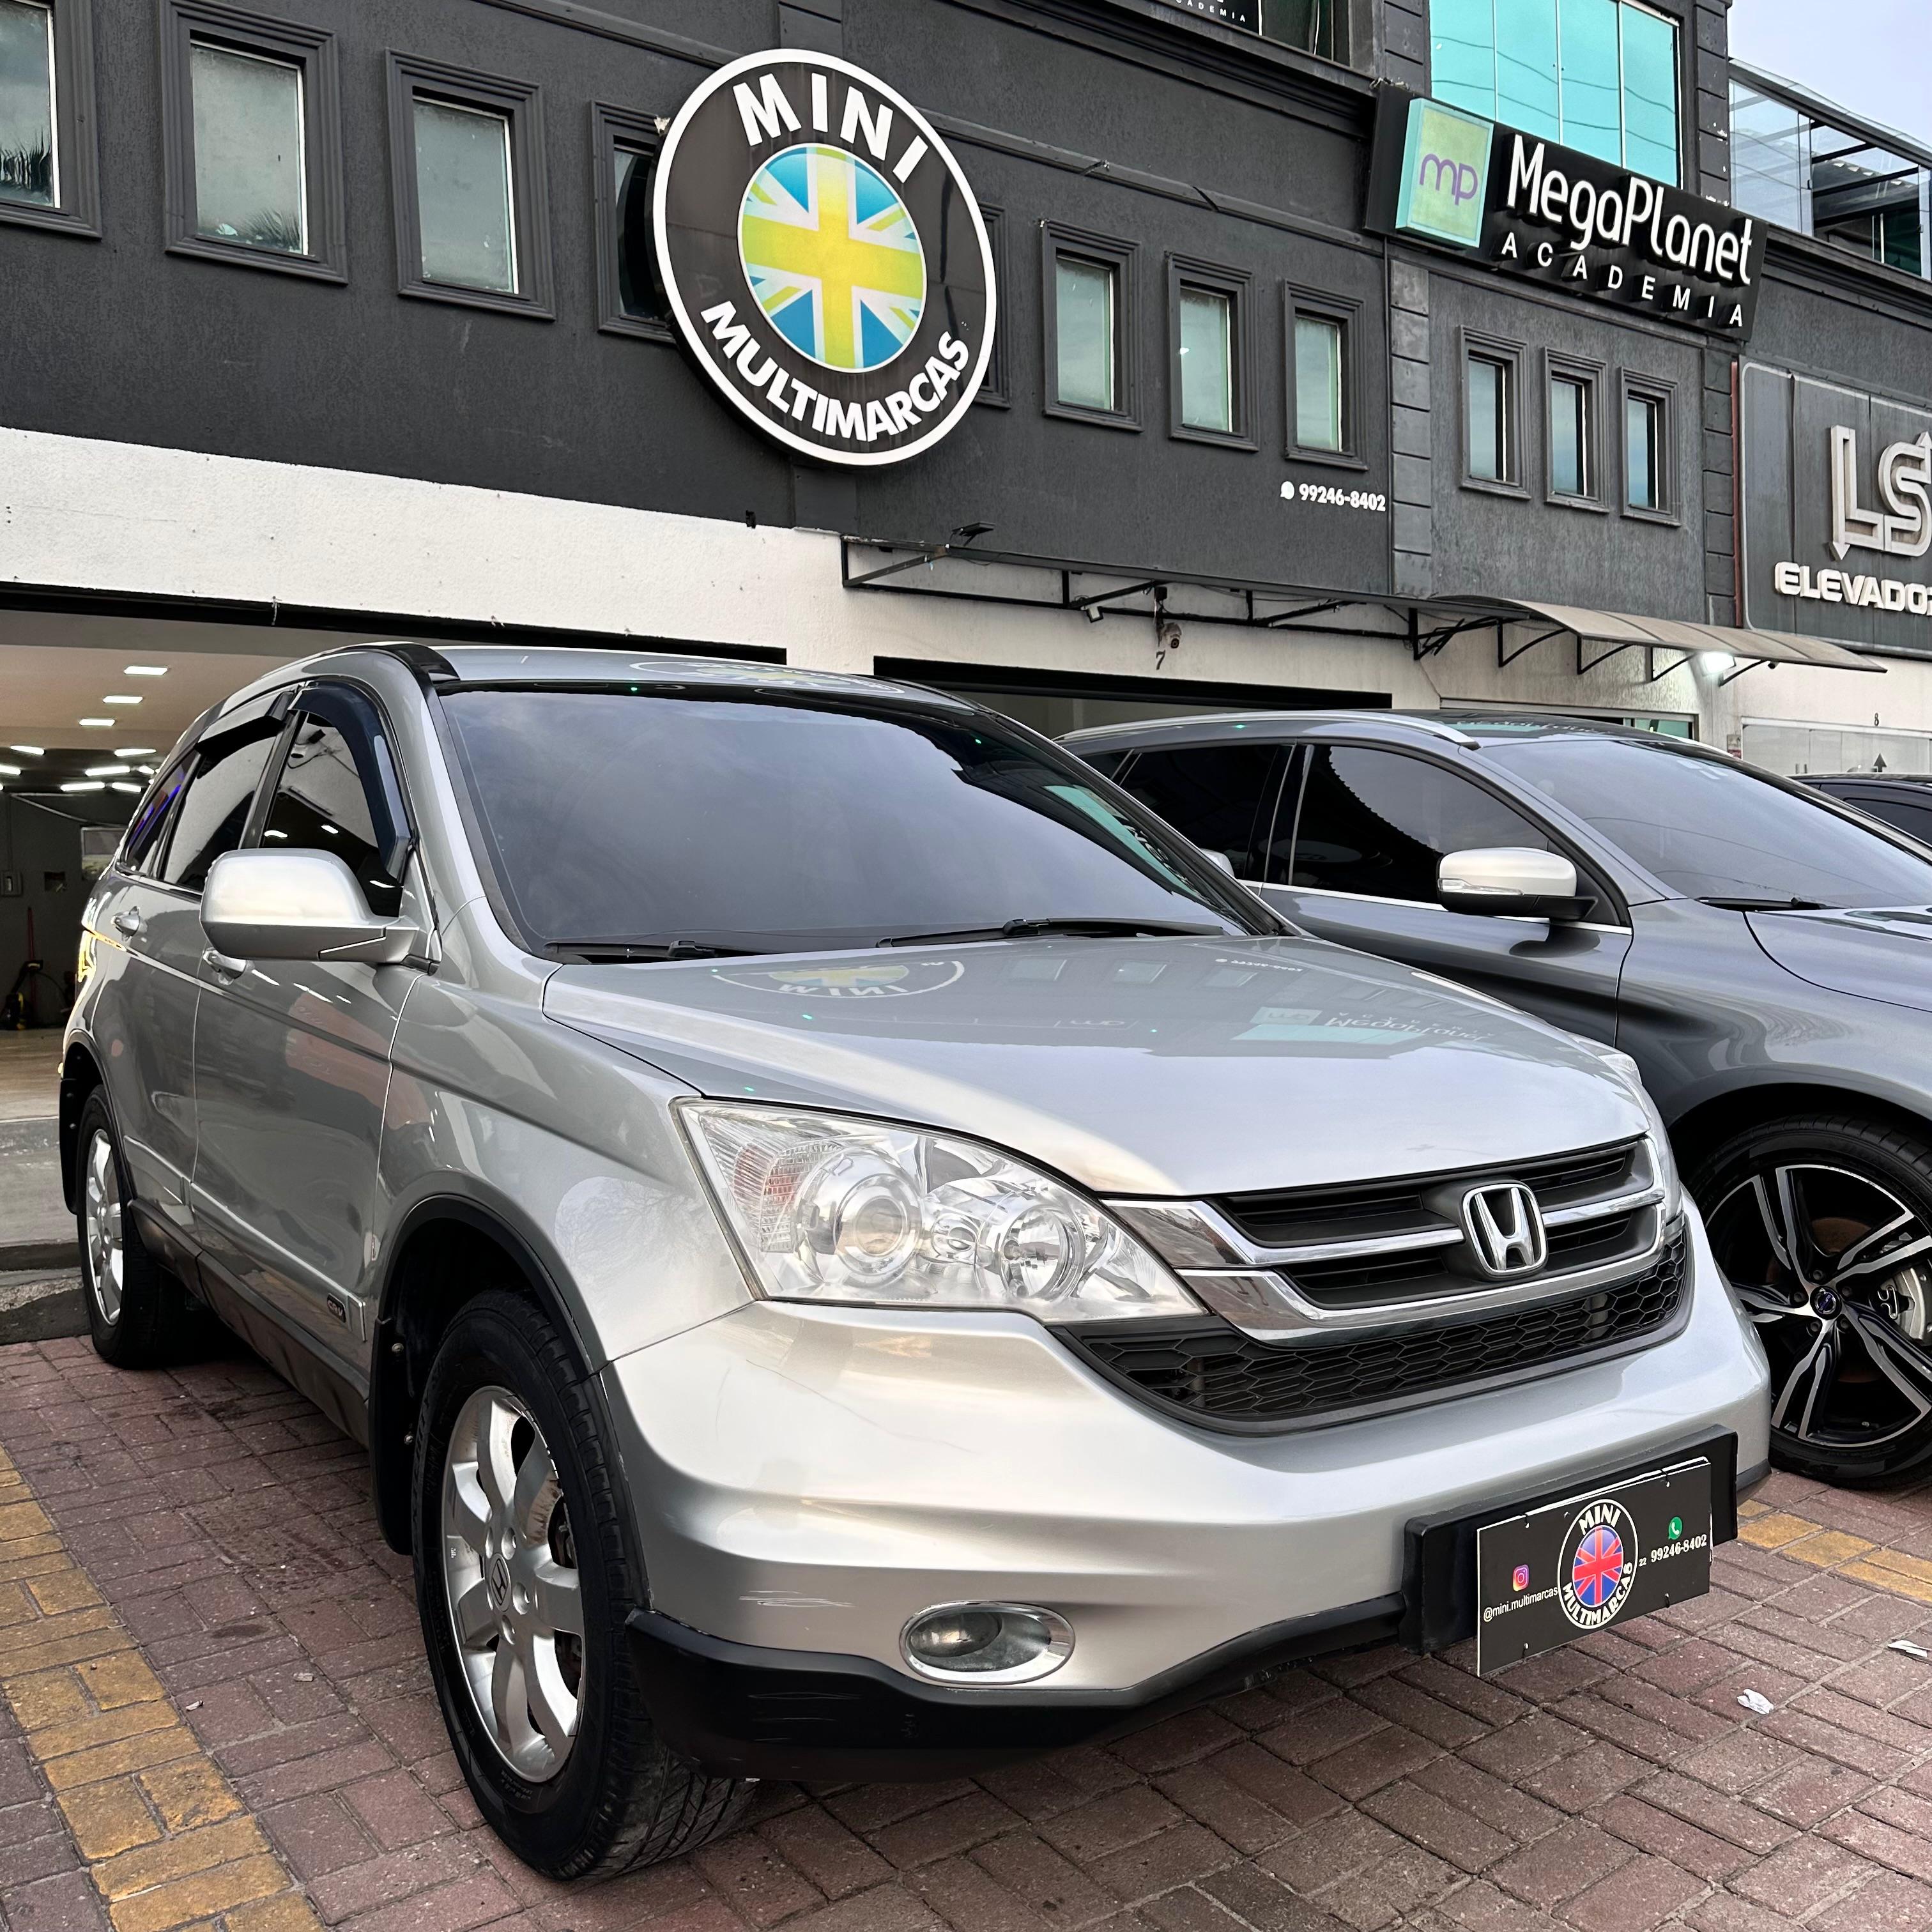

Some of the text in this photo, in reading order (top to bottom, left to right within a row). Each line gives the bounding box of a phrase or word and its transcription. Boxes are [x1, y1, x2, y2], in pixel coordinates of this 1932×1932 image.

[1176, 0, 1245, 22] ADEMIA
[733, 72, 928, 183] MINI
[1506, 134, 1752, 286] MegaPlanet
[1501, 231, 1744, 327] ACADEMIA
[700, 300, 969, 442] MULTIMARCAS
[1298, 483, 1386, 512] 99246-8402
[1774, 561, 1932, 617] ELEVADO
[1155, 649, 1166, 671] 7
[1874, 712, 1880, 726] 8
[1579, 1503, 1621, 1536] MINI
[1639, 1534, 1707, 1567] 22 99246-8402
[1483, 1586, 1558, 1622] @mini.multimarcas
[1563, 1561, 1633, 1626] MULTIMARCAS
